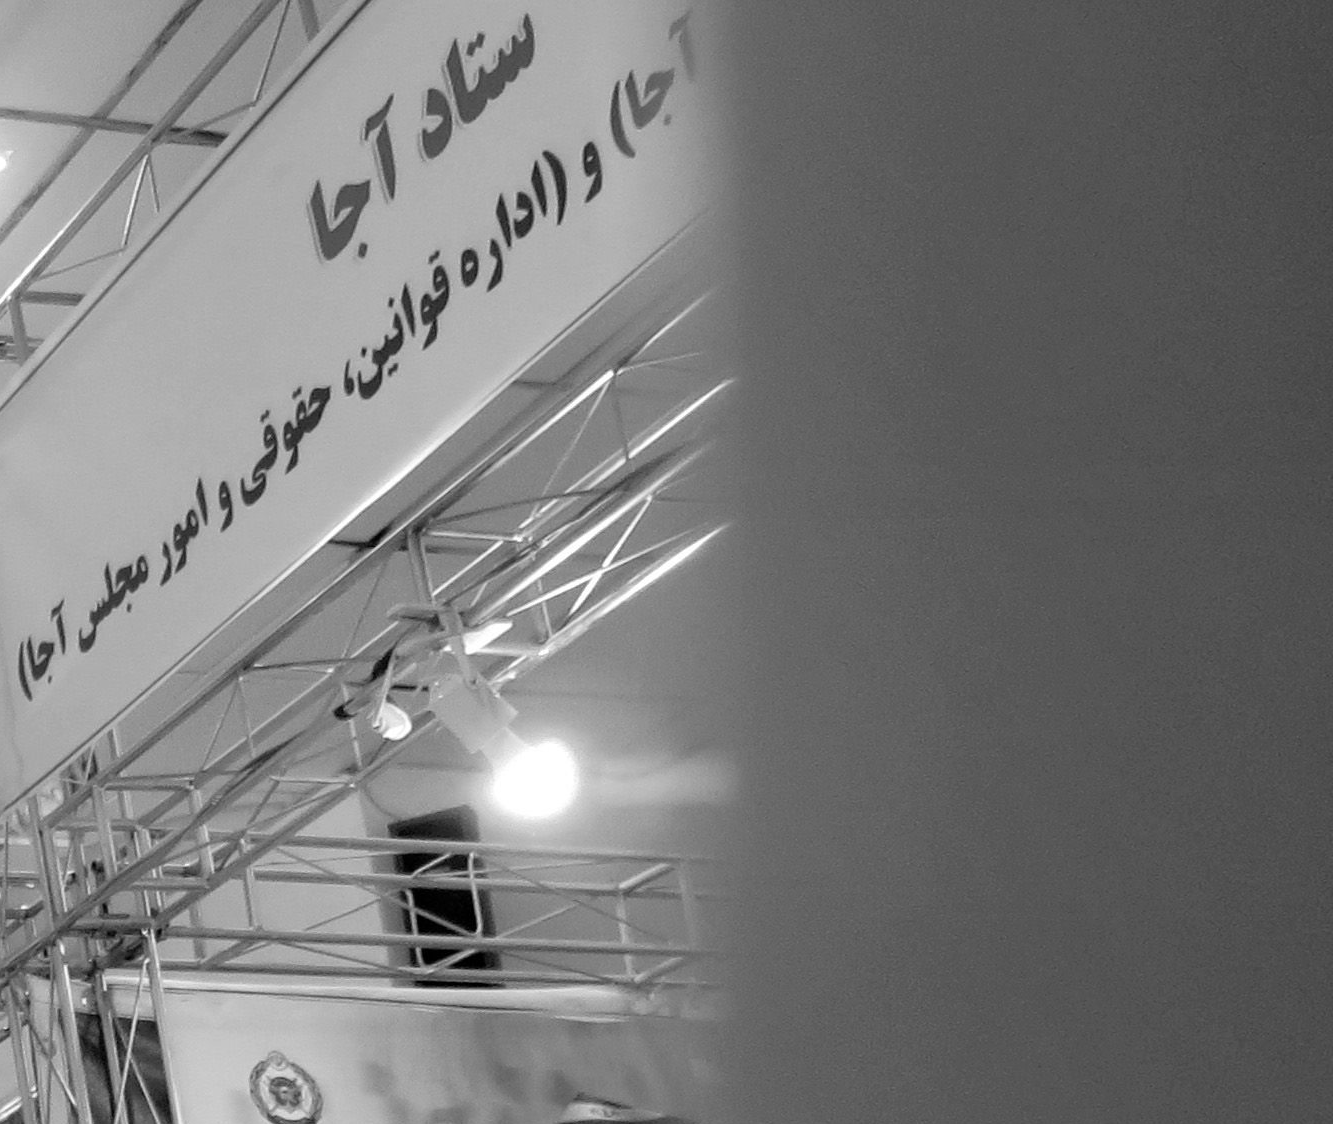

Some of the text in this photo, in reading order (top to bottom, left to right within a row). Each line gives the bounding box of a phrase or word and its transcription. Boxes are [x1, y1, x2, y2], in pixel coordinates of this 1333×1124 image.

[308, 12, 536, 261] ستاد آجا
[582, 140, 603, 204] و
[460, 149, 568, 293] (اداره
[239, 385, 332, 507] حقوقی
[159, 475, 209, 588] امور
[218, 479, 234, 533] و
[17, 597, 67, 702] آجا)
[77, 554, 150, 655] مجلس
